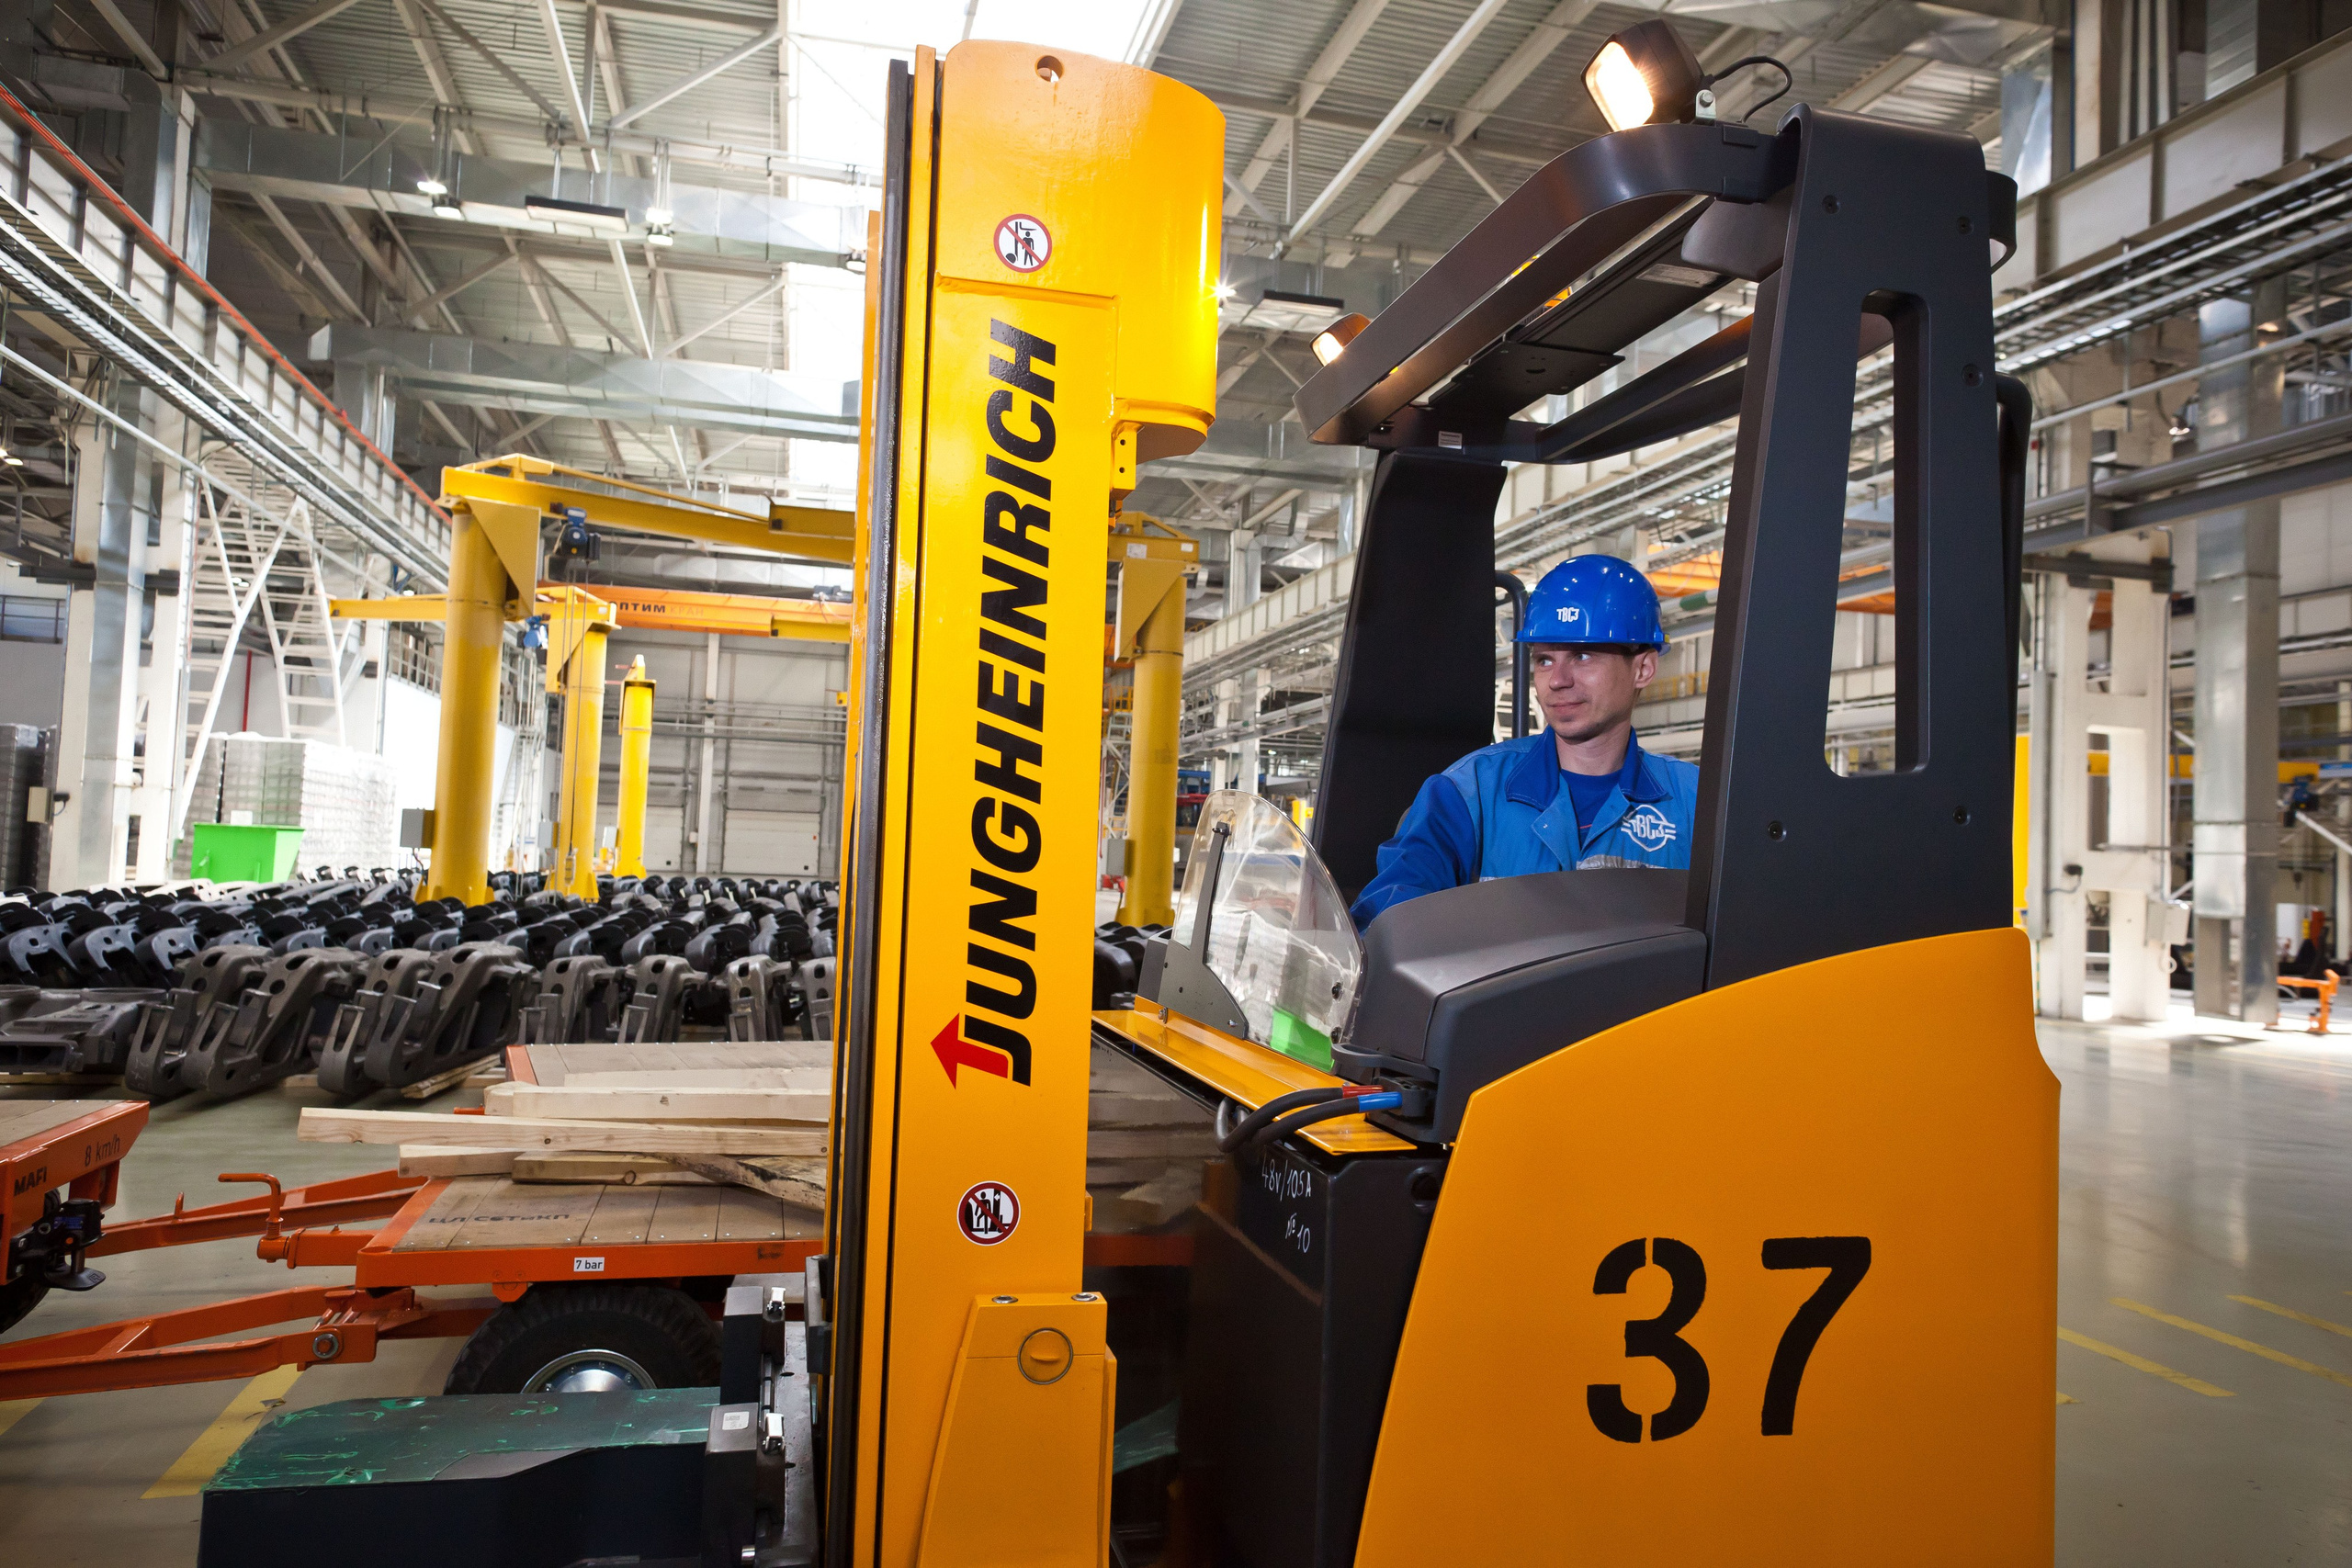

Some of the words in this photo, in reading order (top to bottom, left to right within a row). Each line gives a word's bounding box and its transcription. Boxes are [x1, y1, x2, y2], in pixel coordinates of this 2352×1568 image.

[963, 317, 1057, 1088] JUNGHEINRICH
[85, 1145, 92, 1167] 8
[96, 1133, 120, 1162] km/h
[14, 1166, 48, 1197] MAFI
[575, 1259, 582, 1269] 7
[584, 1259, 603, 1269] bar
[1586, 1235, 1872, 1444] 37
